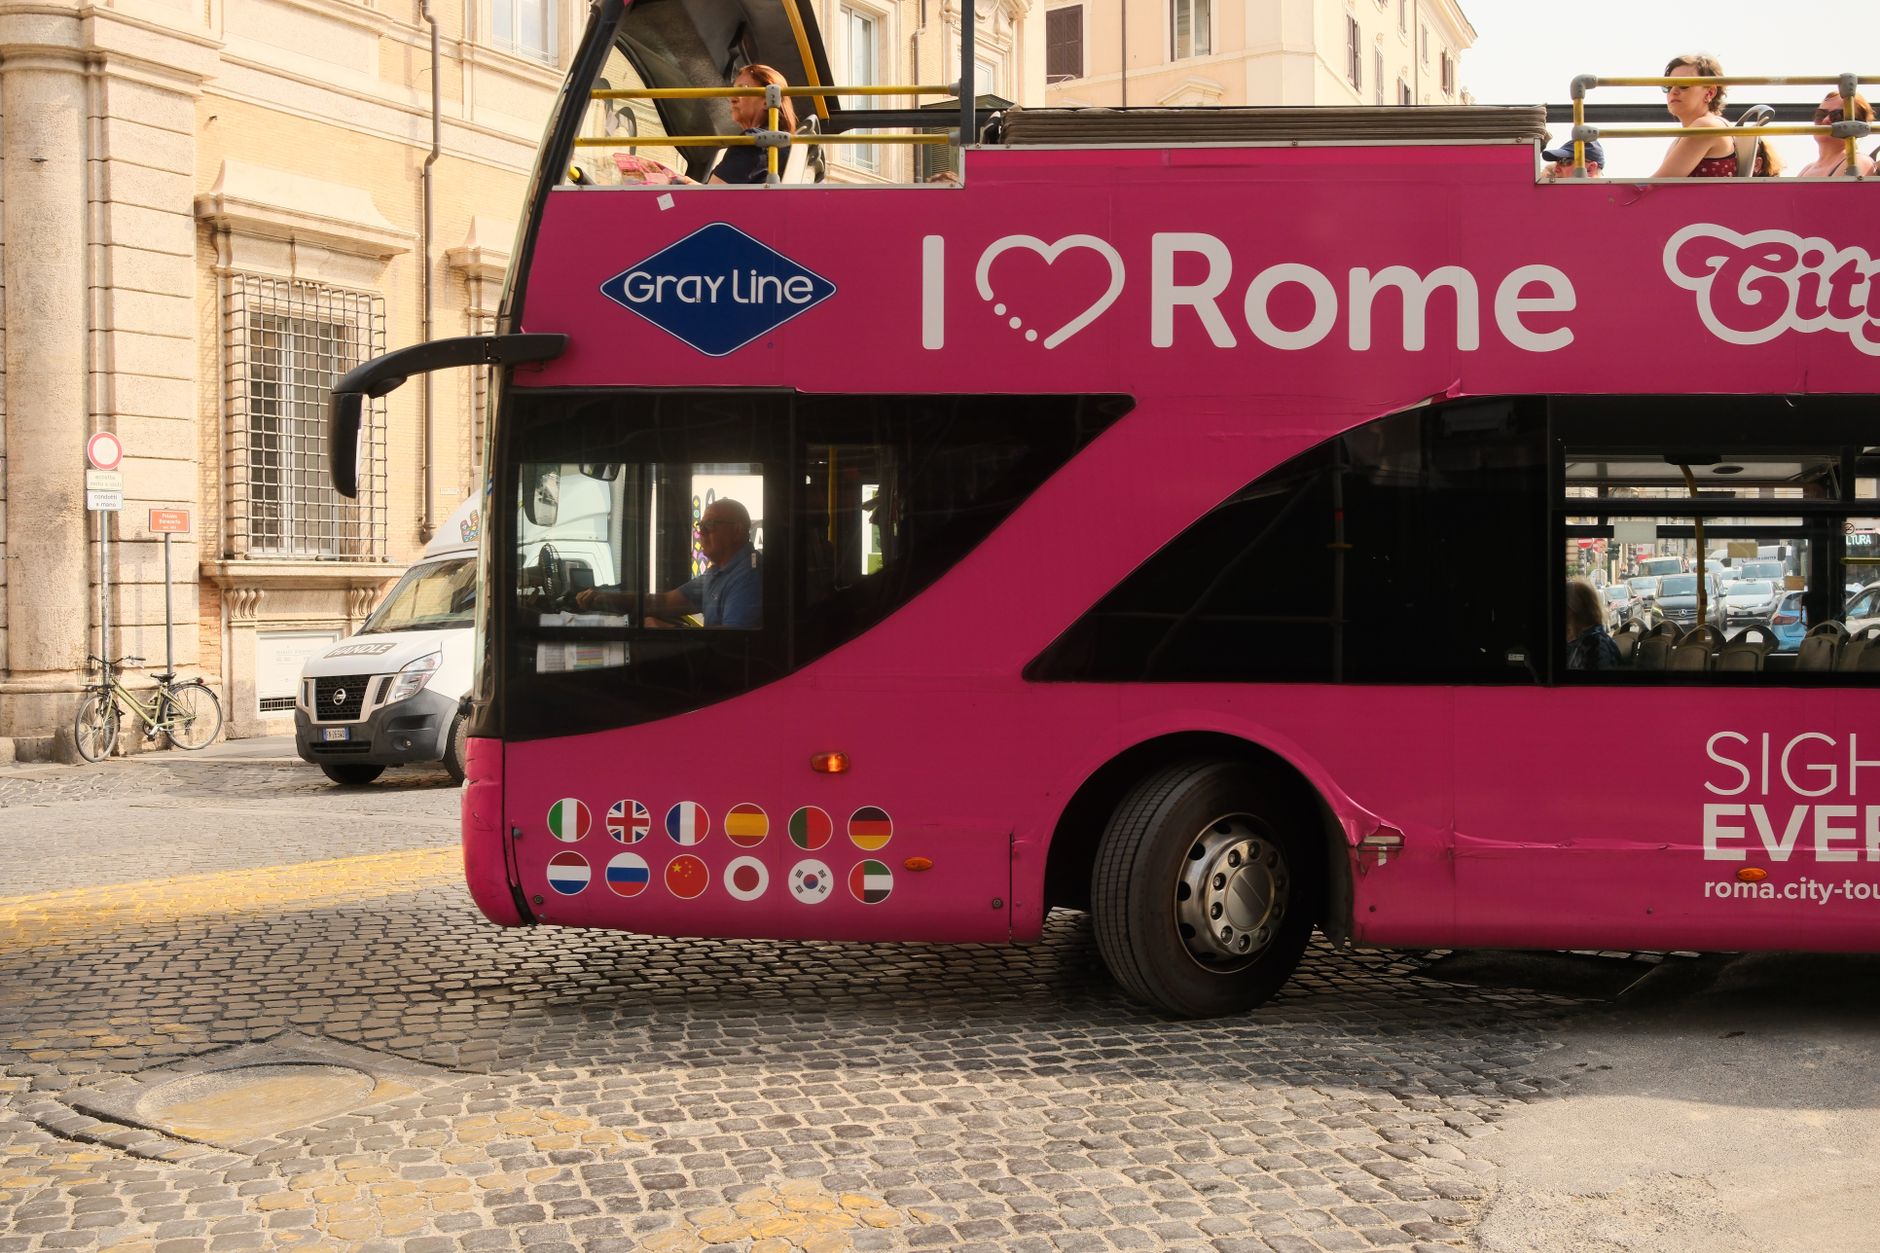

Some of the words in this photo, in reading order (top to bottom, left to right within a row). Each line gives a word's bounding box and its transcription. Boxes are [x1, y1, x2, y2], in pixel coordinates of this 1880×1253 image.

[732, 269, 813, 304] Line
[922, 235, 944, 350] I
[1151, 232, 1577, 353] Rome
